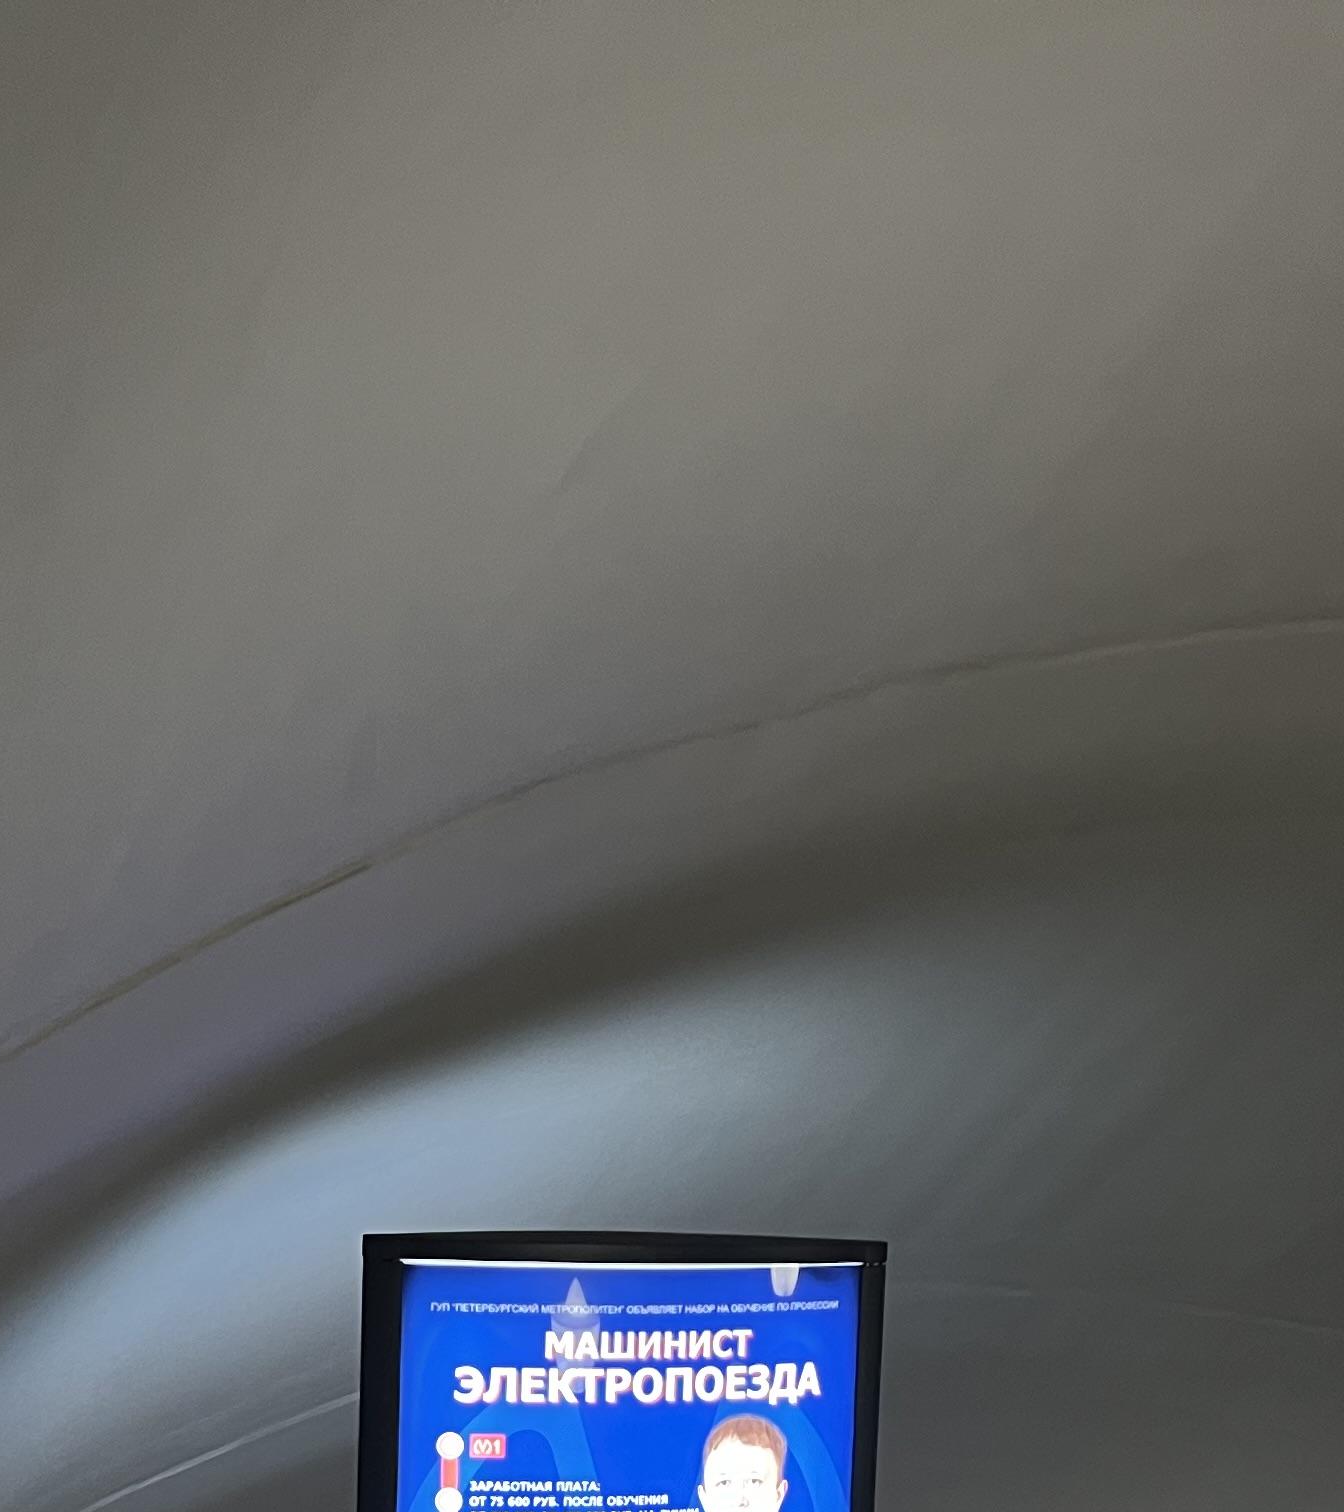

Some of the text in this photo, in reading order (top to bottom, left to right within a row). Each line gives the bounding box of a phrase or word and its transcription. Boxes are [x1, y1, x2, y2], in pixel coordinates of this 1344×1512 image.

[430, 1302, 450, 1311] ГУП
[626, 1304, 683, 1315] ОБЪЯВЛЯЕТ
[685, 1304, 715, 1314] НАБОР
[717, 1304, 729, 1313] НА
[731, 1302, 775, 1312] ОБУЧЕНИЕ
[777, 1301, 789, 1311] ПО
[790, 1300, 839, 1311] ПРОФЕССИИ
[544, 1329, 753, 1360] МАШИНИСТ
[453, 1361, 821, 1404] ЭЛЕКТРОПОЕЗДА
[469, 1480, 601, 1492] ЗАРАБОТНАЯ ПЛАТА:
[469, 1496, 487, 1507] ОТ
[490, 1496, 504, 1507] 75
[533, 1496, 559, 1507] РУБ.
[563, 1495, 603, 1507] ПОСЛЕ
[607, 1494, 669, 1506] ОБУЧЕНИЯ
